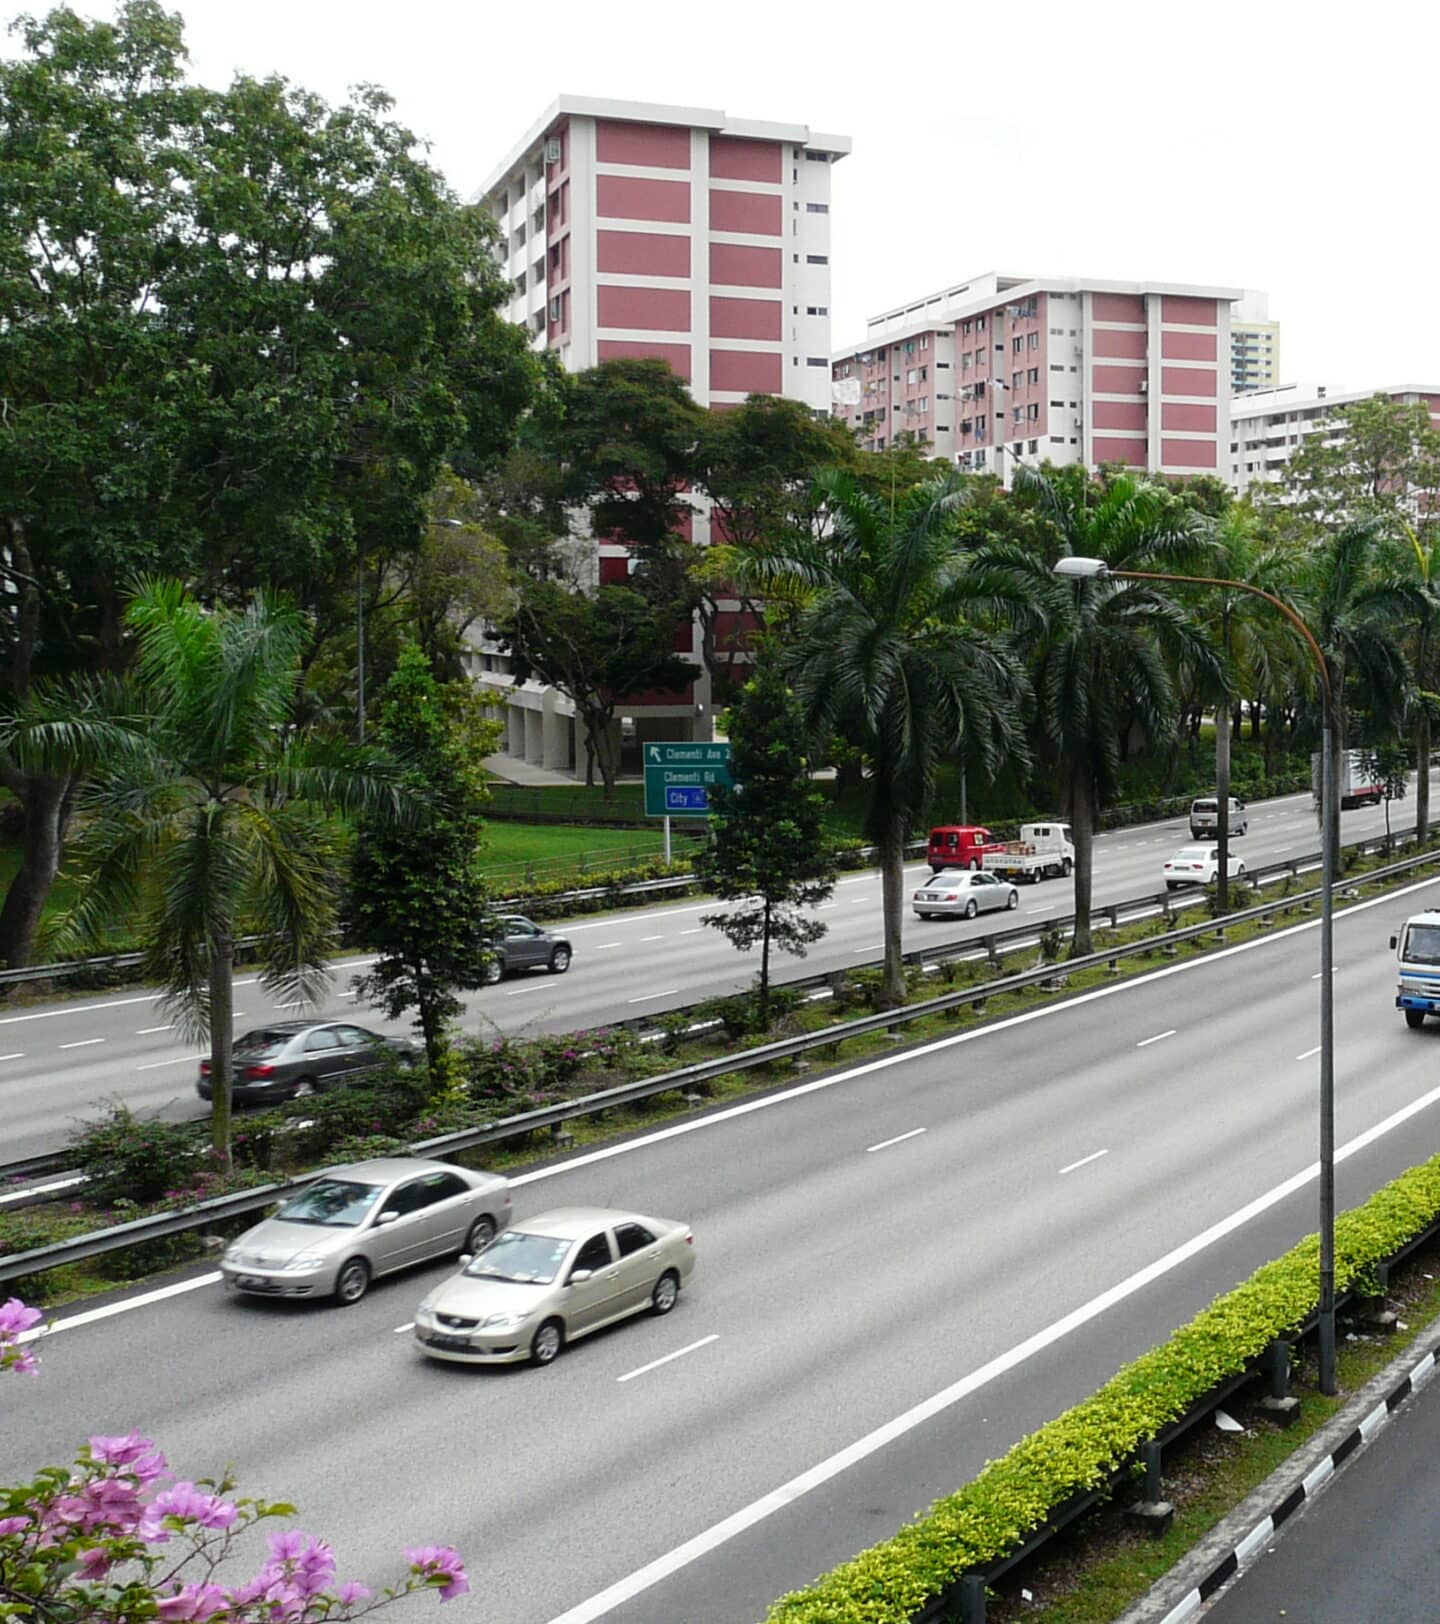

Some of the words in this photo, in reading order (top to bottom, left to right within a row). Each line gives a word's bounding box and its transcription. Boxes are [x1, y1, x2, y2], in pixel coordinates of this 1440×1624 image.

[666, 748, 703, 760] Clementi
[706, 748, 721, 760] Ave
[664, 770, 700, 783] Clementi
[670, 792, 689, 806] City
